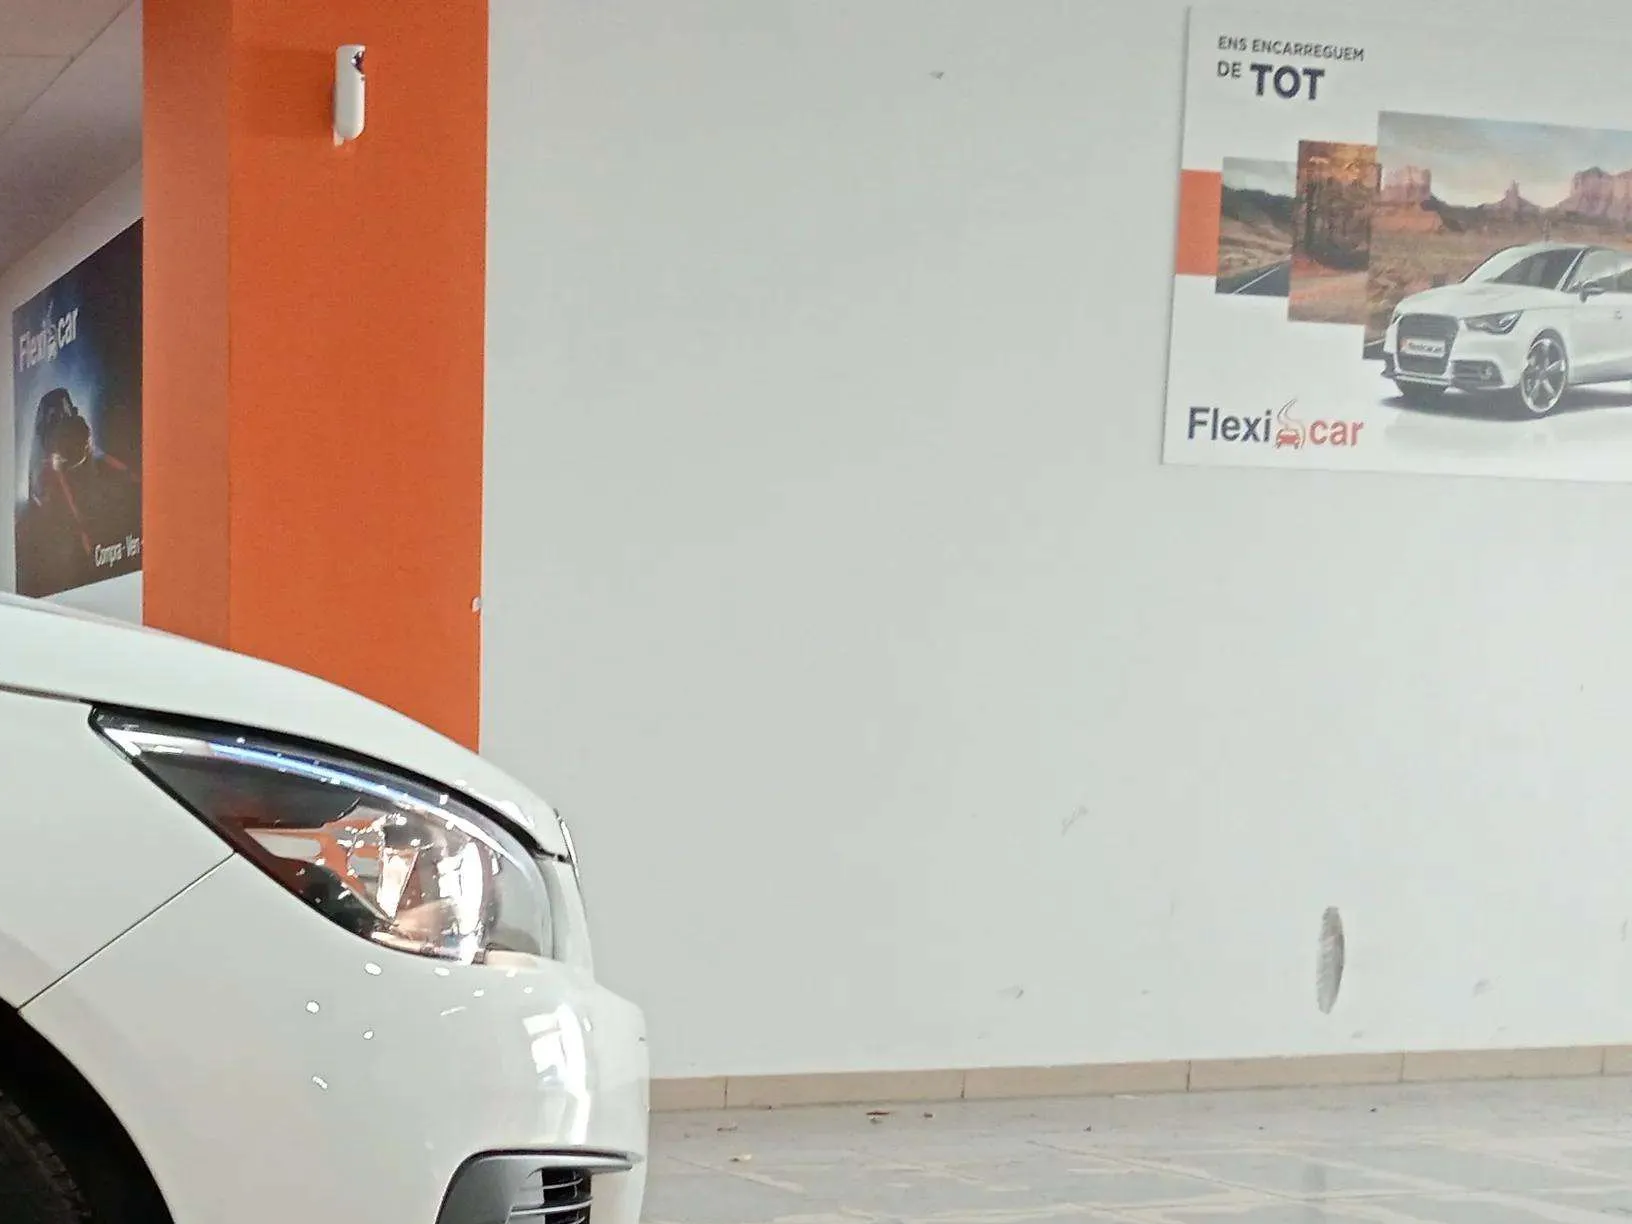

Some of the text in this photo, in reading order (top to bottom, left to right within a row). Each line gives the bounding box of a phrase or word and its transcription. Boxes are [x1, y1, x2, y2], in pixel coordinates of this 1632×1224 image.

[1218, 36, 1364, 61] ENS ENCARREGUEM
[1217, 61, 1325, 100] DE TOT
[58, 307, 79, 349] car
[1187, 406, 1364, 446] Flexi car
